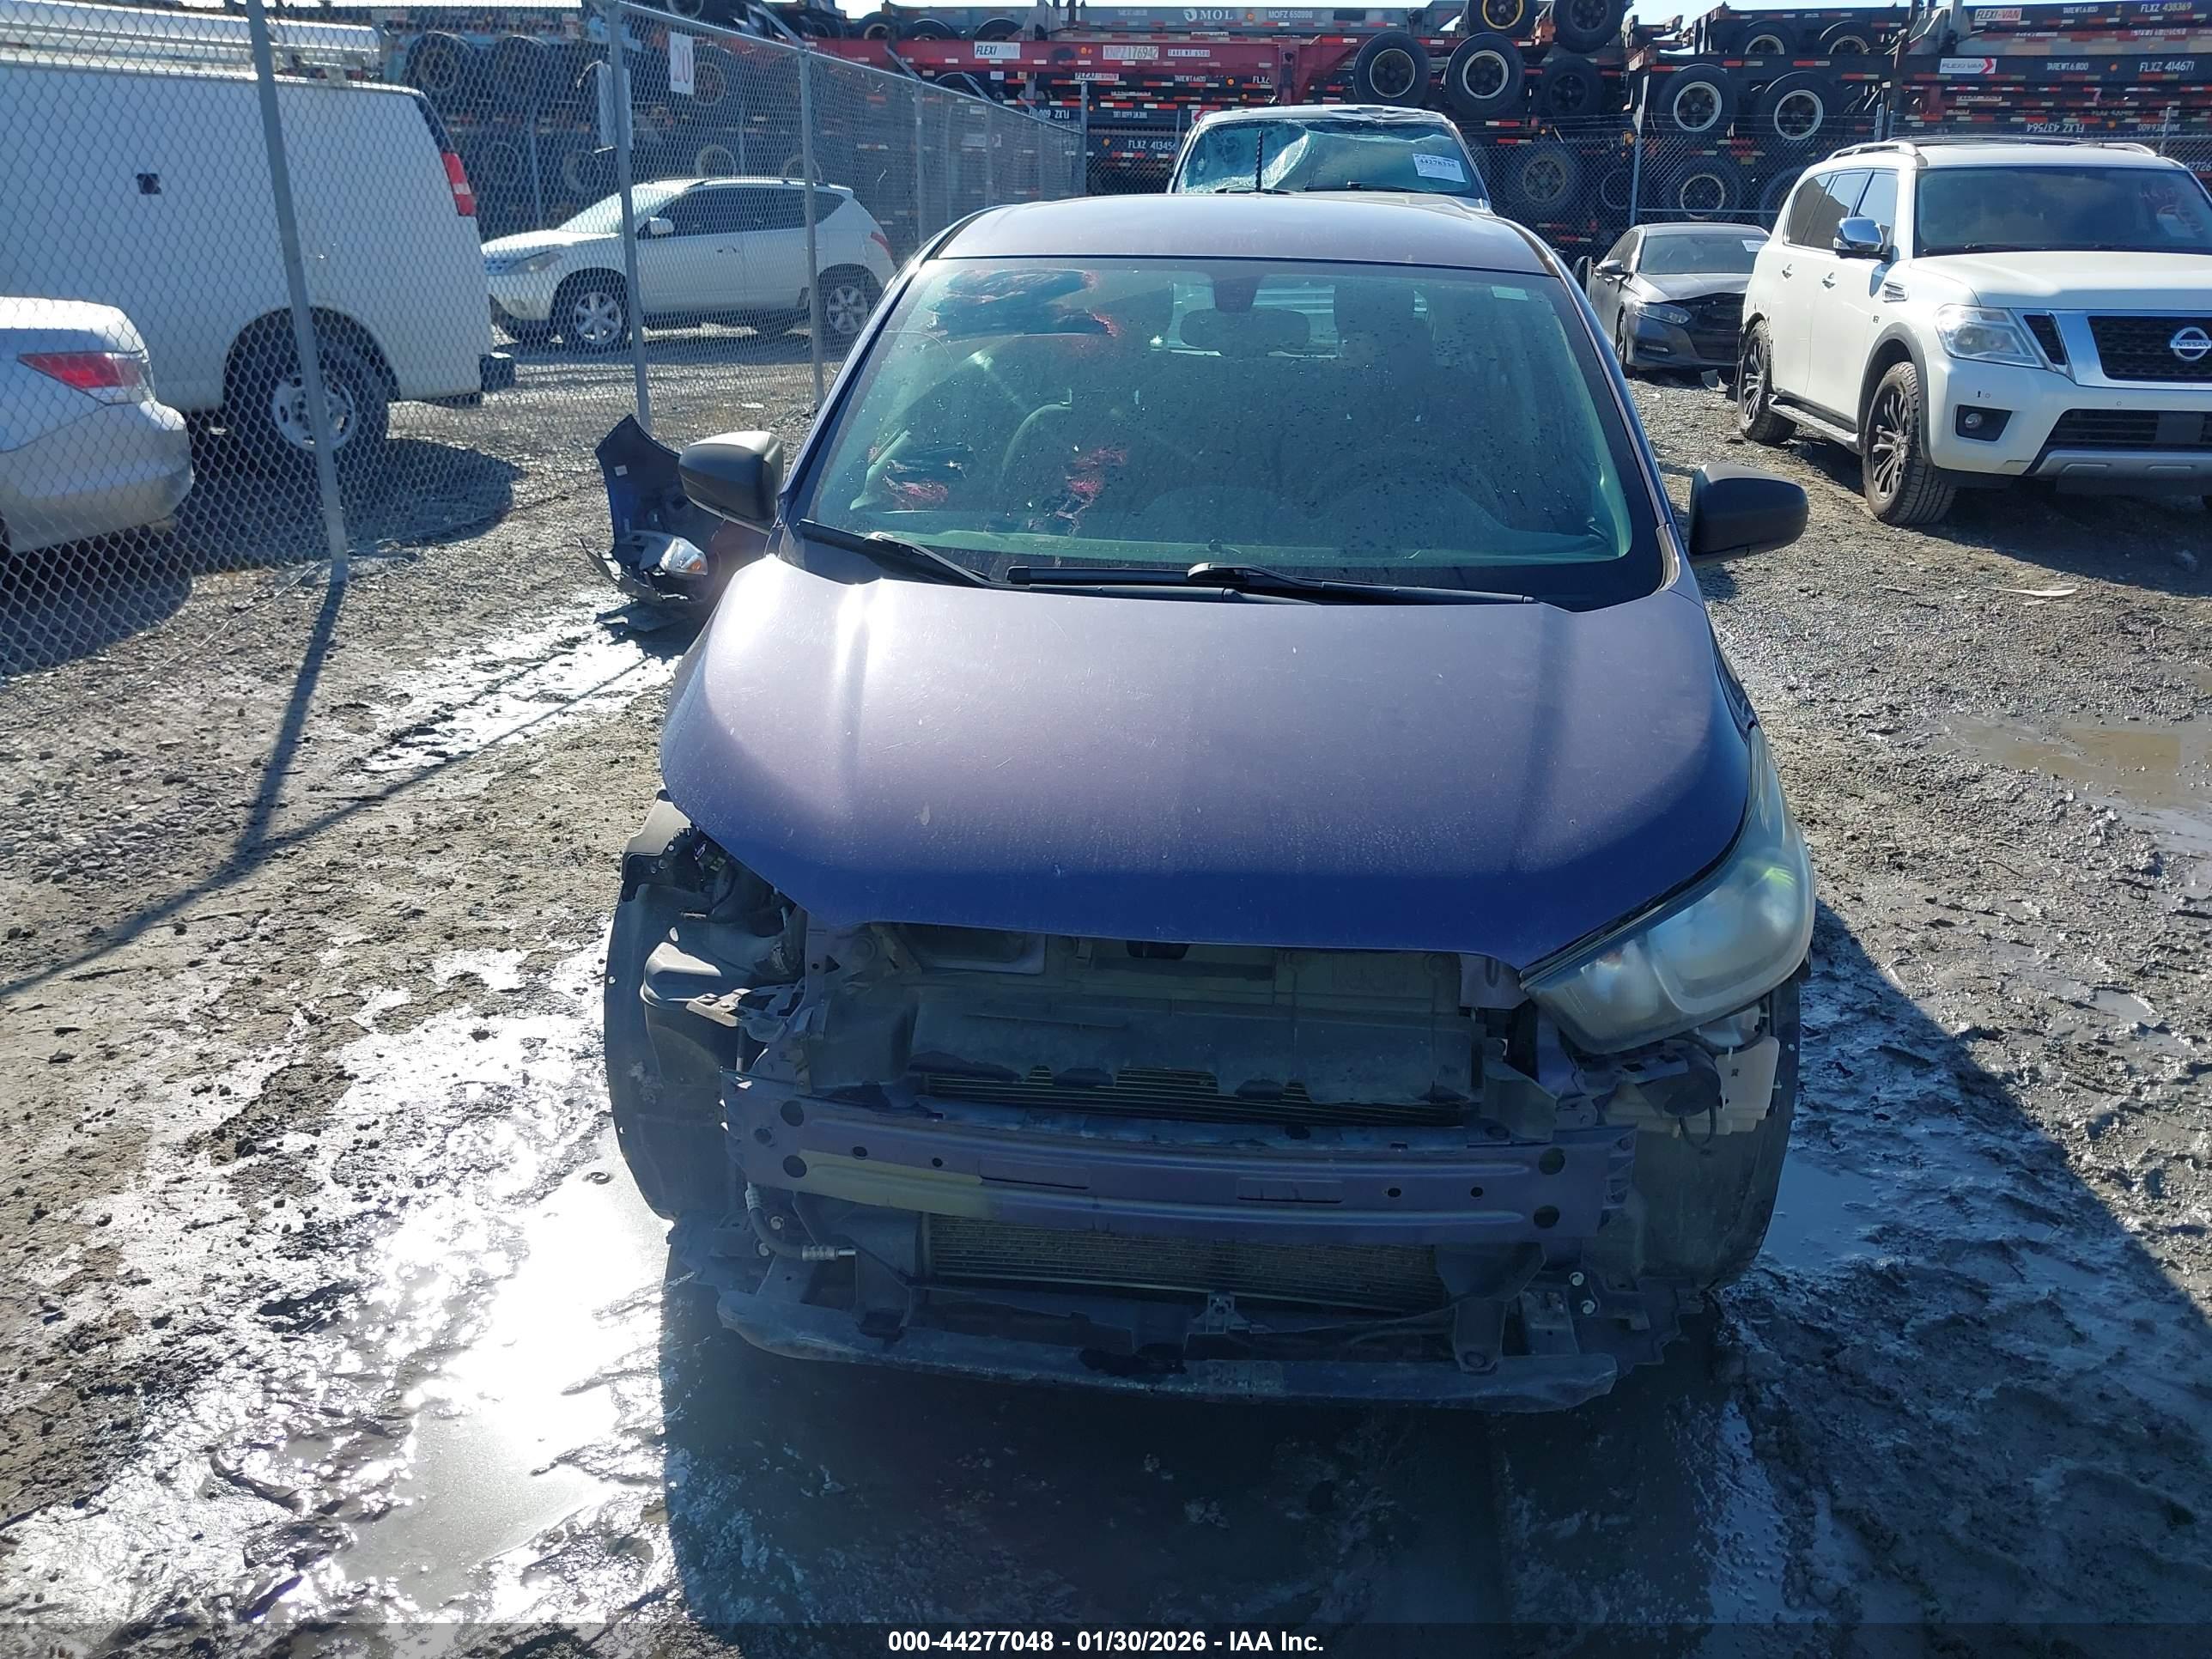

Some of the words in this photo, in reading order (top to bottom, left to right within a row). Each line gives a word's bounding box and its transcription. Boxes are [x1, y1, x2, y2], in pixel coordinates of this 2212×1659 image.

[2140, 3, 2160, 13] FLXZ
[1200, 9, 1233, 20] MOL
[975, 45, 998, 55] FLEXI
[2139, 62, 2163, 72] FLXZ
[2165, 61, 2195, 71] 414671
[2027, 123, 2060, 132] 437564
[2061, 123, 2085, 133] FLXZ
[1127, 140, 1146, 149] FLXZ
